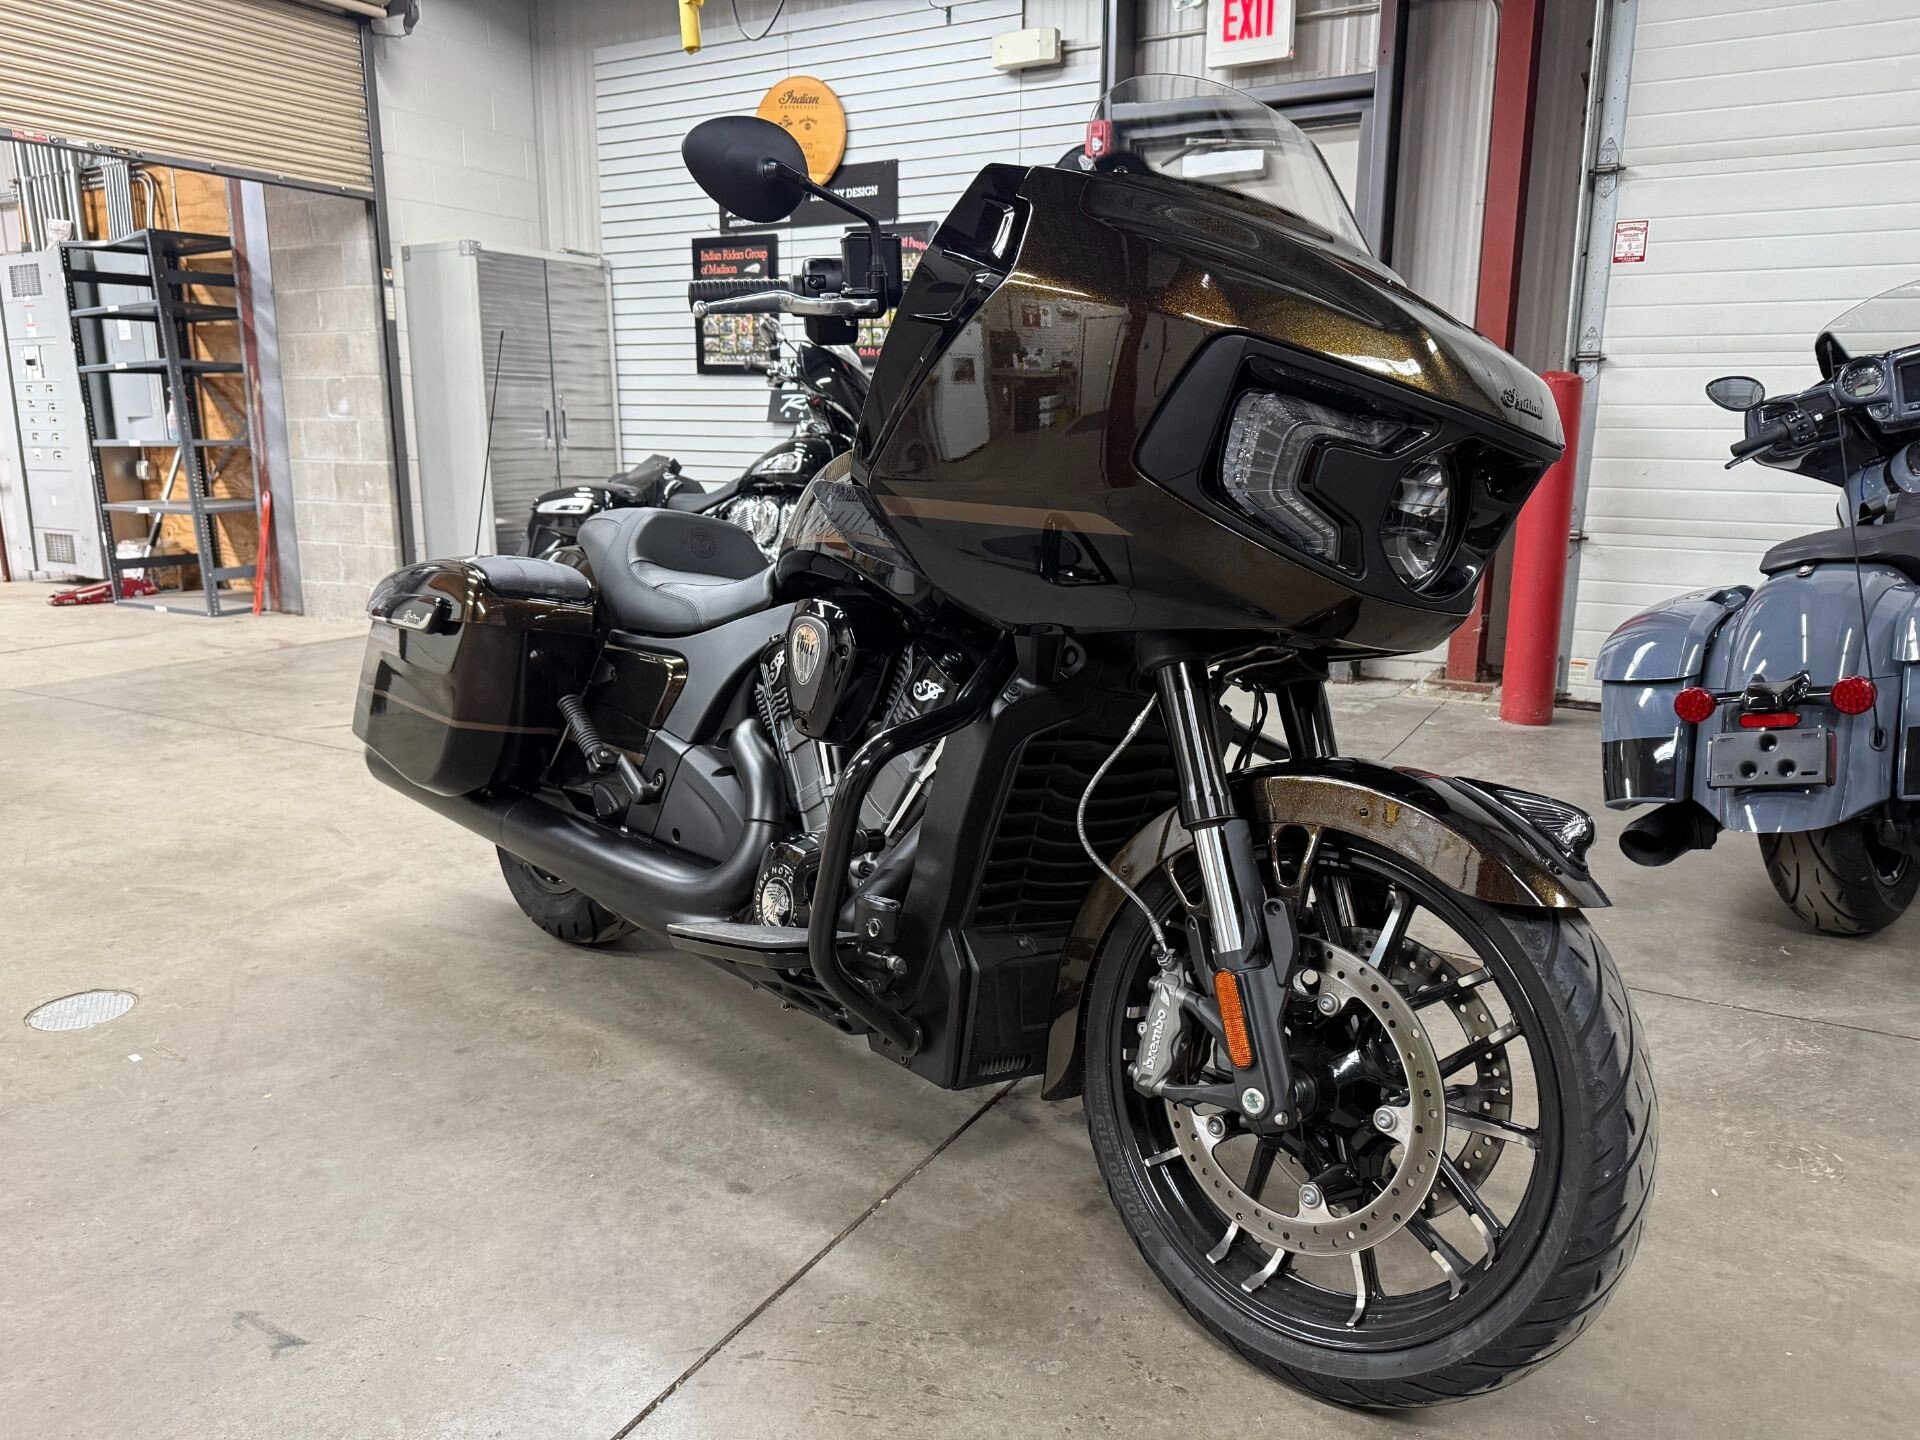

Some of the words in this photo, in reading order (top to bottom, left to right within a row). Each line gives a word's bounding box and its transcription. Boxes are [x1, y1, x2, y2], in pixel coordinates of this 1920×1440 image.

[778, 90, 820, 105] Indian
[846, 185, 878, 199] DESIGN
[700, 250, 722, 261] Indian
[722, 249, 744, 260] Riders
[744, 248, 768, 261] Group
[701, 264, 708, 275] of
[709, 263, 737, 274] Madison
[796, 640, 814, 655] 1901
[755, 871, 769, 920] INDIAN
[1142, 1008, 1168, 1071] brembo
